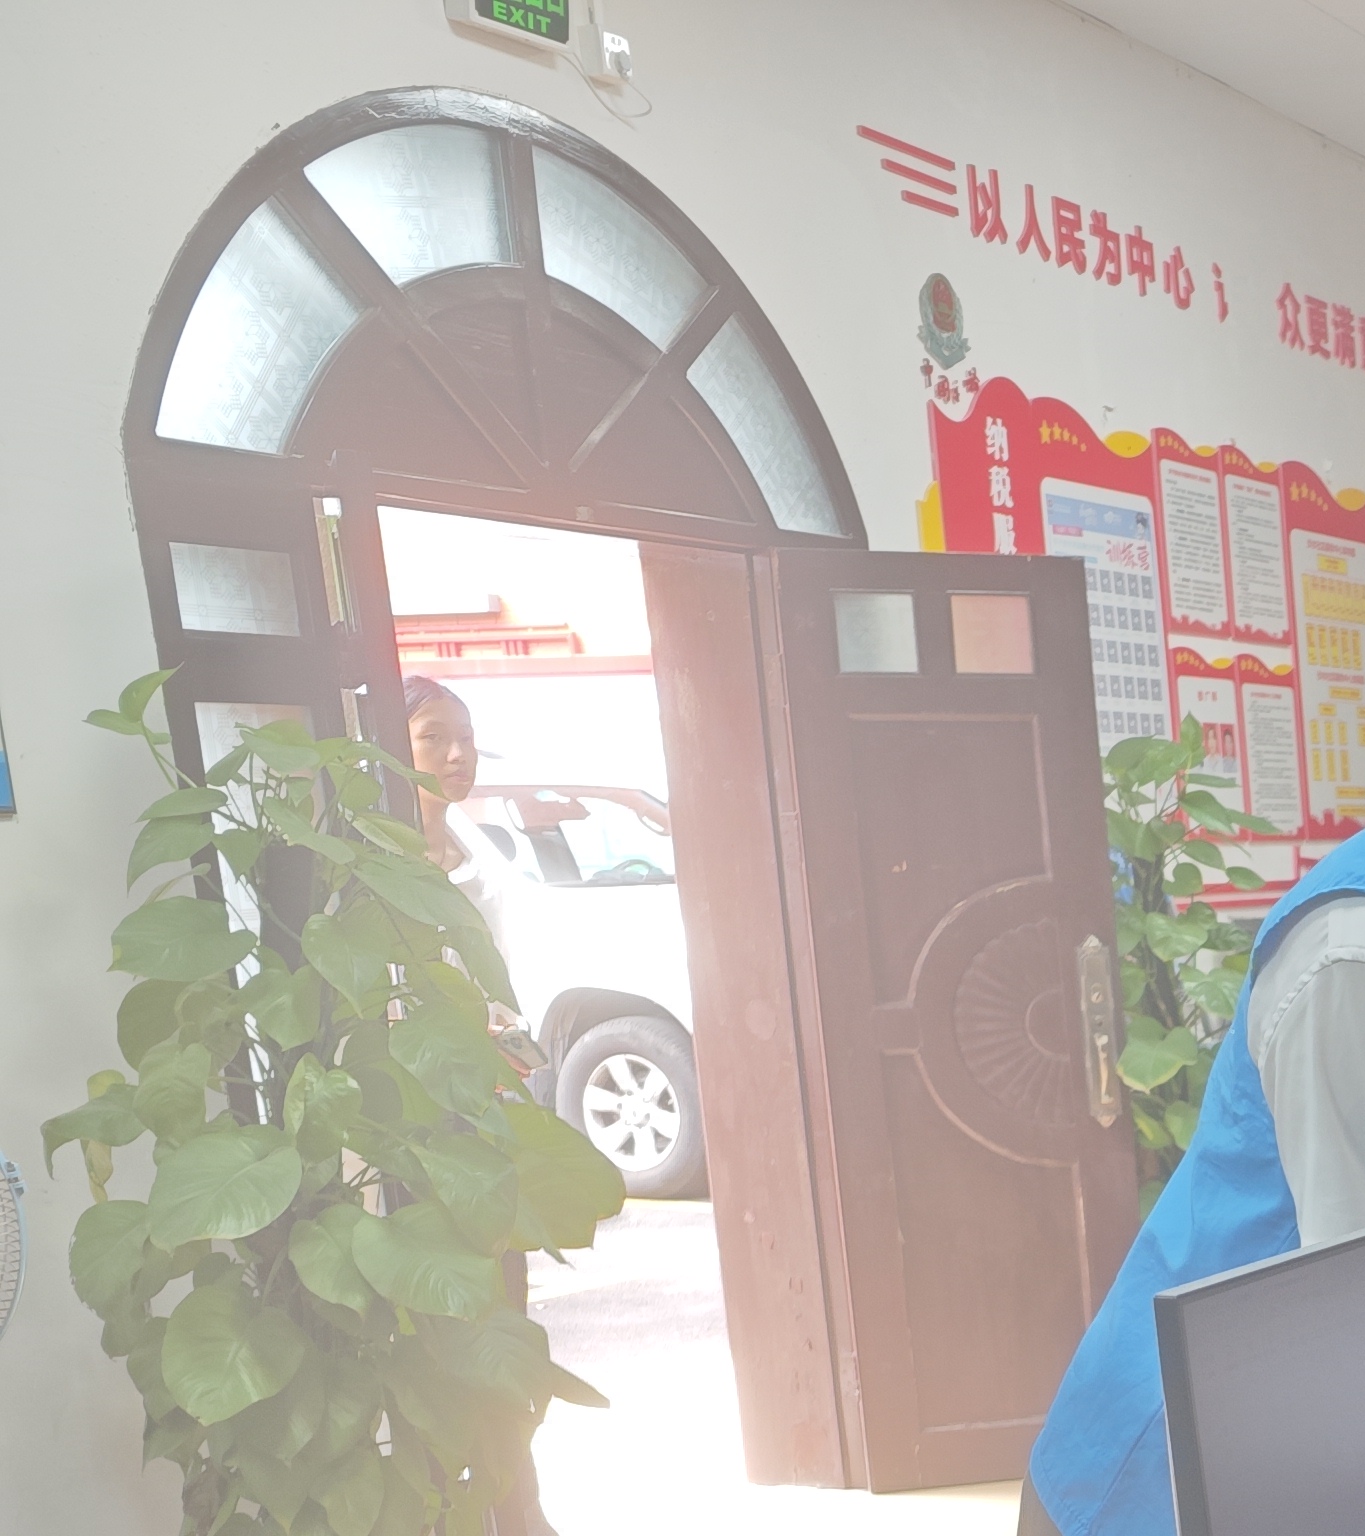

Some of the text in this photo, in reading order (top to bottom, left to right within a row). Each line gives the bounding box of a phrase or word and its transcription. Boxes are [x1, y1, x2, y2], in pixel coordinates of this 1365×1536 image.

[492, 1, 551, 34] EXIT
[966, 163, 1196, 309] 以人民为中心
